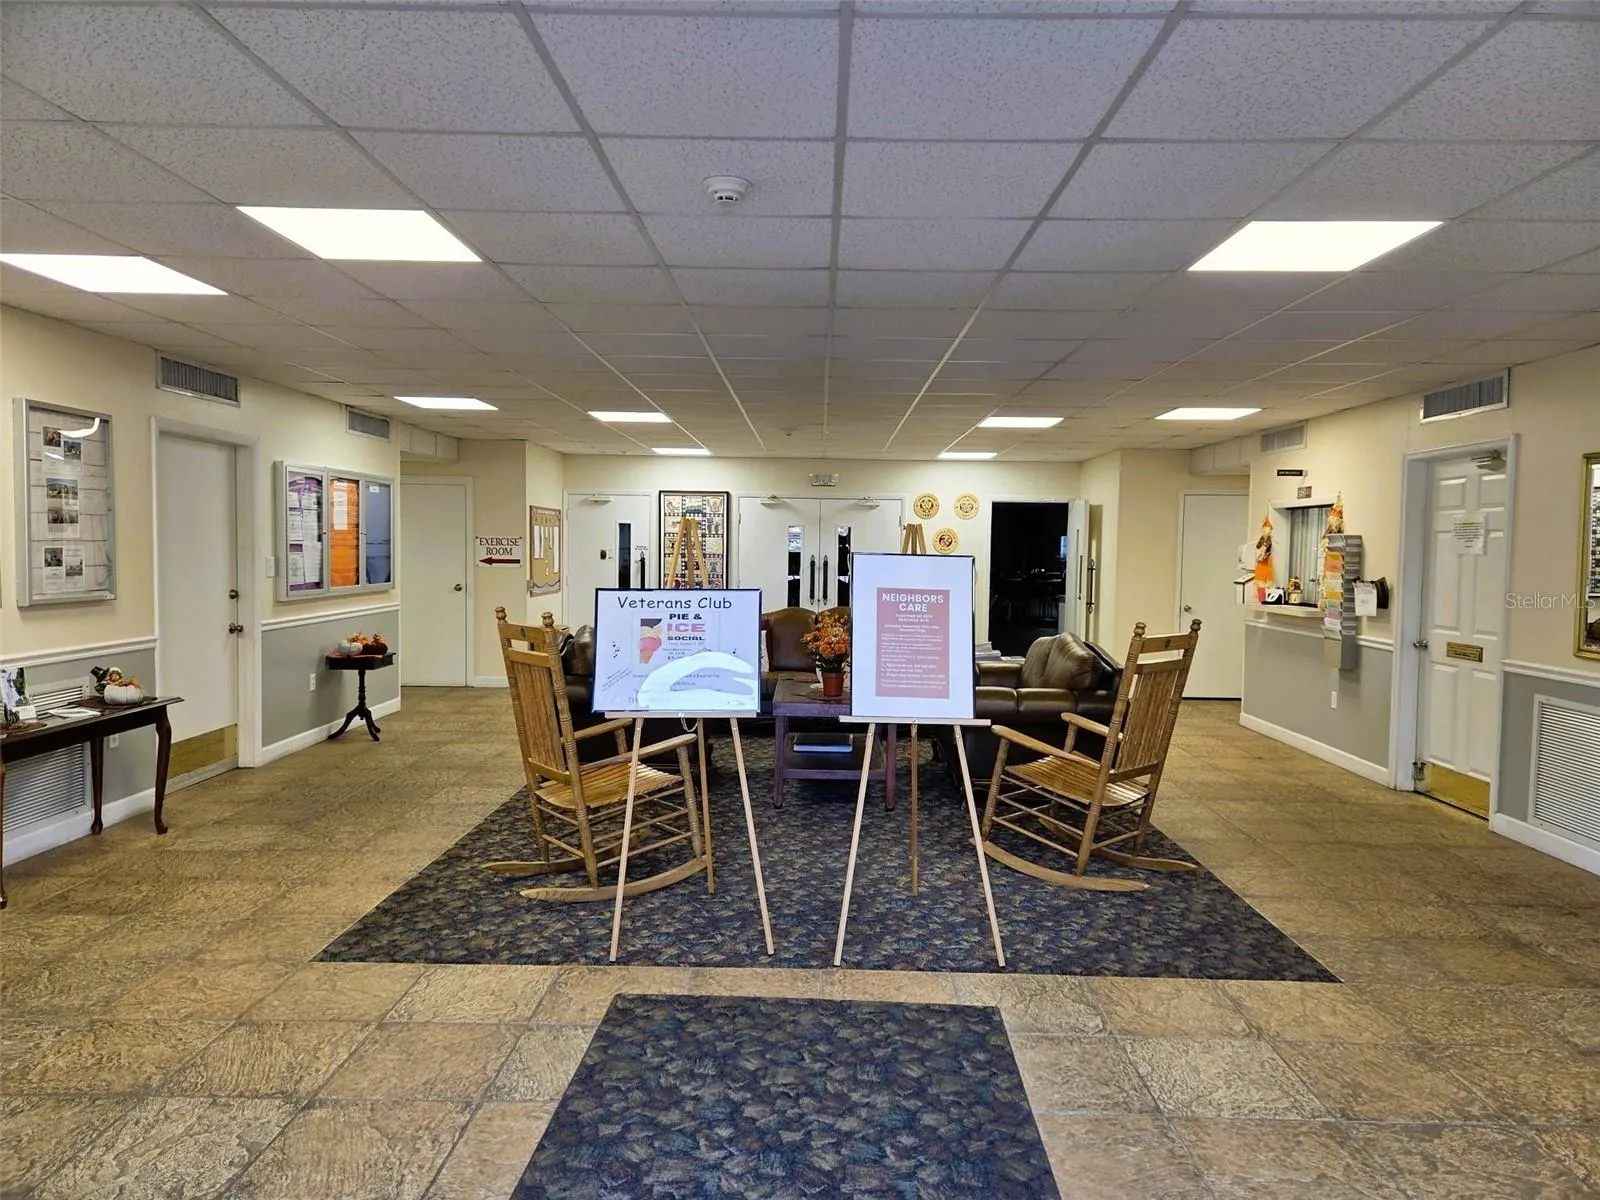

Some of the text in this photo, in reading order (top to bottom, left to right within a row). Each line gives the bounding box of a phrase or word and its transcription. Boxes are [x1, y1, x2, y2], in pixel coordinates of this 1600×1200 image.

[479, 537, 520, 546] EXERCISE
[486, 547, 513, 556] ROOM
[617, 596, 732, 609] Veterans Club
[882, 593, 944, 603] NEIGHBORS
[899, 603, 928, 612] CARE
[666, 623, 706, 633] ICE
